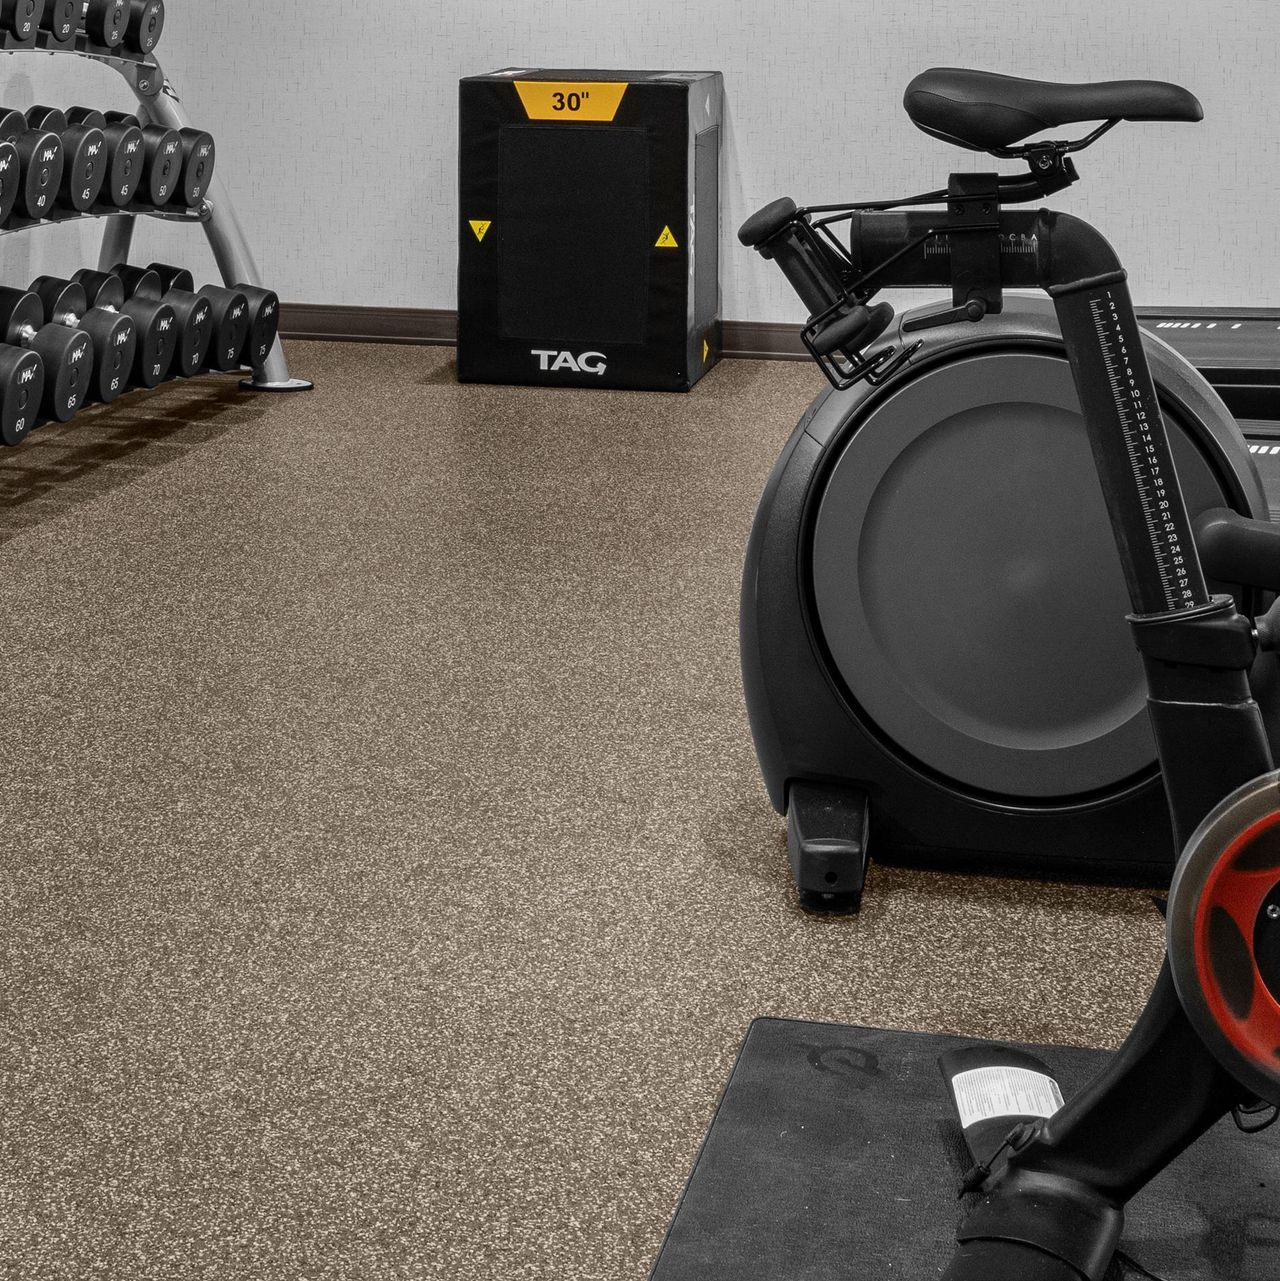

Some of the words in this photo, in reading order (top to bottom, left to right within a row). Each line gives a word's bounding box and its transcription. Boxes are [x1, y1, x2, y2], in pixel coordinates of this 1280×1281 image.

[22, 22, 31, 32] 20
[61, 23, 70, 34] 20
[551, 90, 590, 112] 30"
[81, 187, 91, 200] 45
[120, 184, 129, 196] 45
[159, 184, 167, 197] 50
[192, 186, 200, 198] 50
[36, 194, 46, 207] 40
[1009, 233, 1016, 241] C
[1031, 233, 1038, 241] A
[227, 347, 235, 359] 75
[531, 349, 607, 375] TAG
[152, 363, 161, 376] 70
[110, 377, 119, 391] 65
[1130, 389, 1141, 398] 10
[67, 394, 77, 409] 65
[1133, 400, 1143, 409] 11
[1136, 411, 1147, 421] 12
[15, 417, 25, 432] 60
[1139, 422, 1149, 431] 13
[1142, 434, 1152, 443] 14
[1144, 444, 1155, 454] 15
[1147, 456, 1158, 465] 16
[1150, 466, 1160, 476] 17
[1153, 477, 1164, 487] 18
[1156, 488, 1166, 498] 19
[1158, 500, 1169, 510] 20
[1161, 511, 1171, 521] 21
[1164, 522, 1175, 532] 22
[1167, 533, 1178, 543] 23
[1170, 544, 1181, 554] 24
[1173, 555, 1184, 565] 25
[1175, 567, 1187, 577] 26
[1178, 578, 1189, 588] 27
[1181, 589, 1193, 599] 28
[1184, 600, 1195, 609] 29
